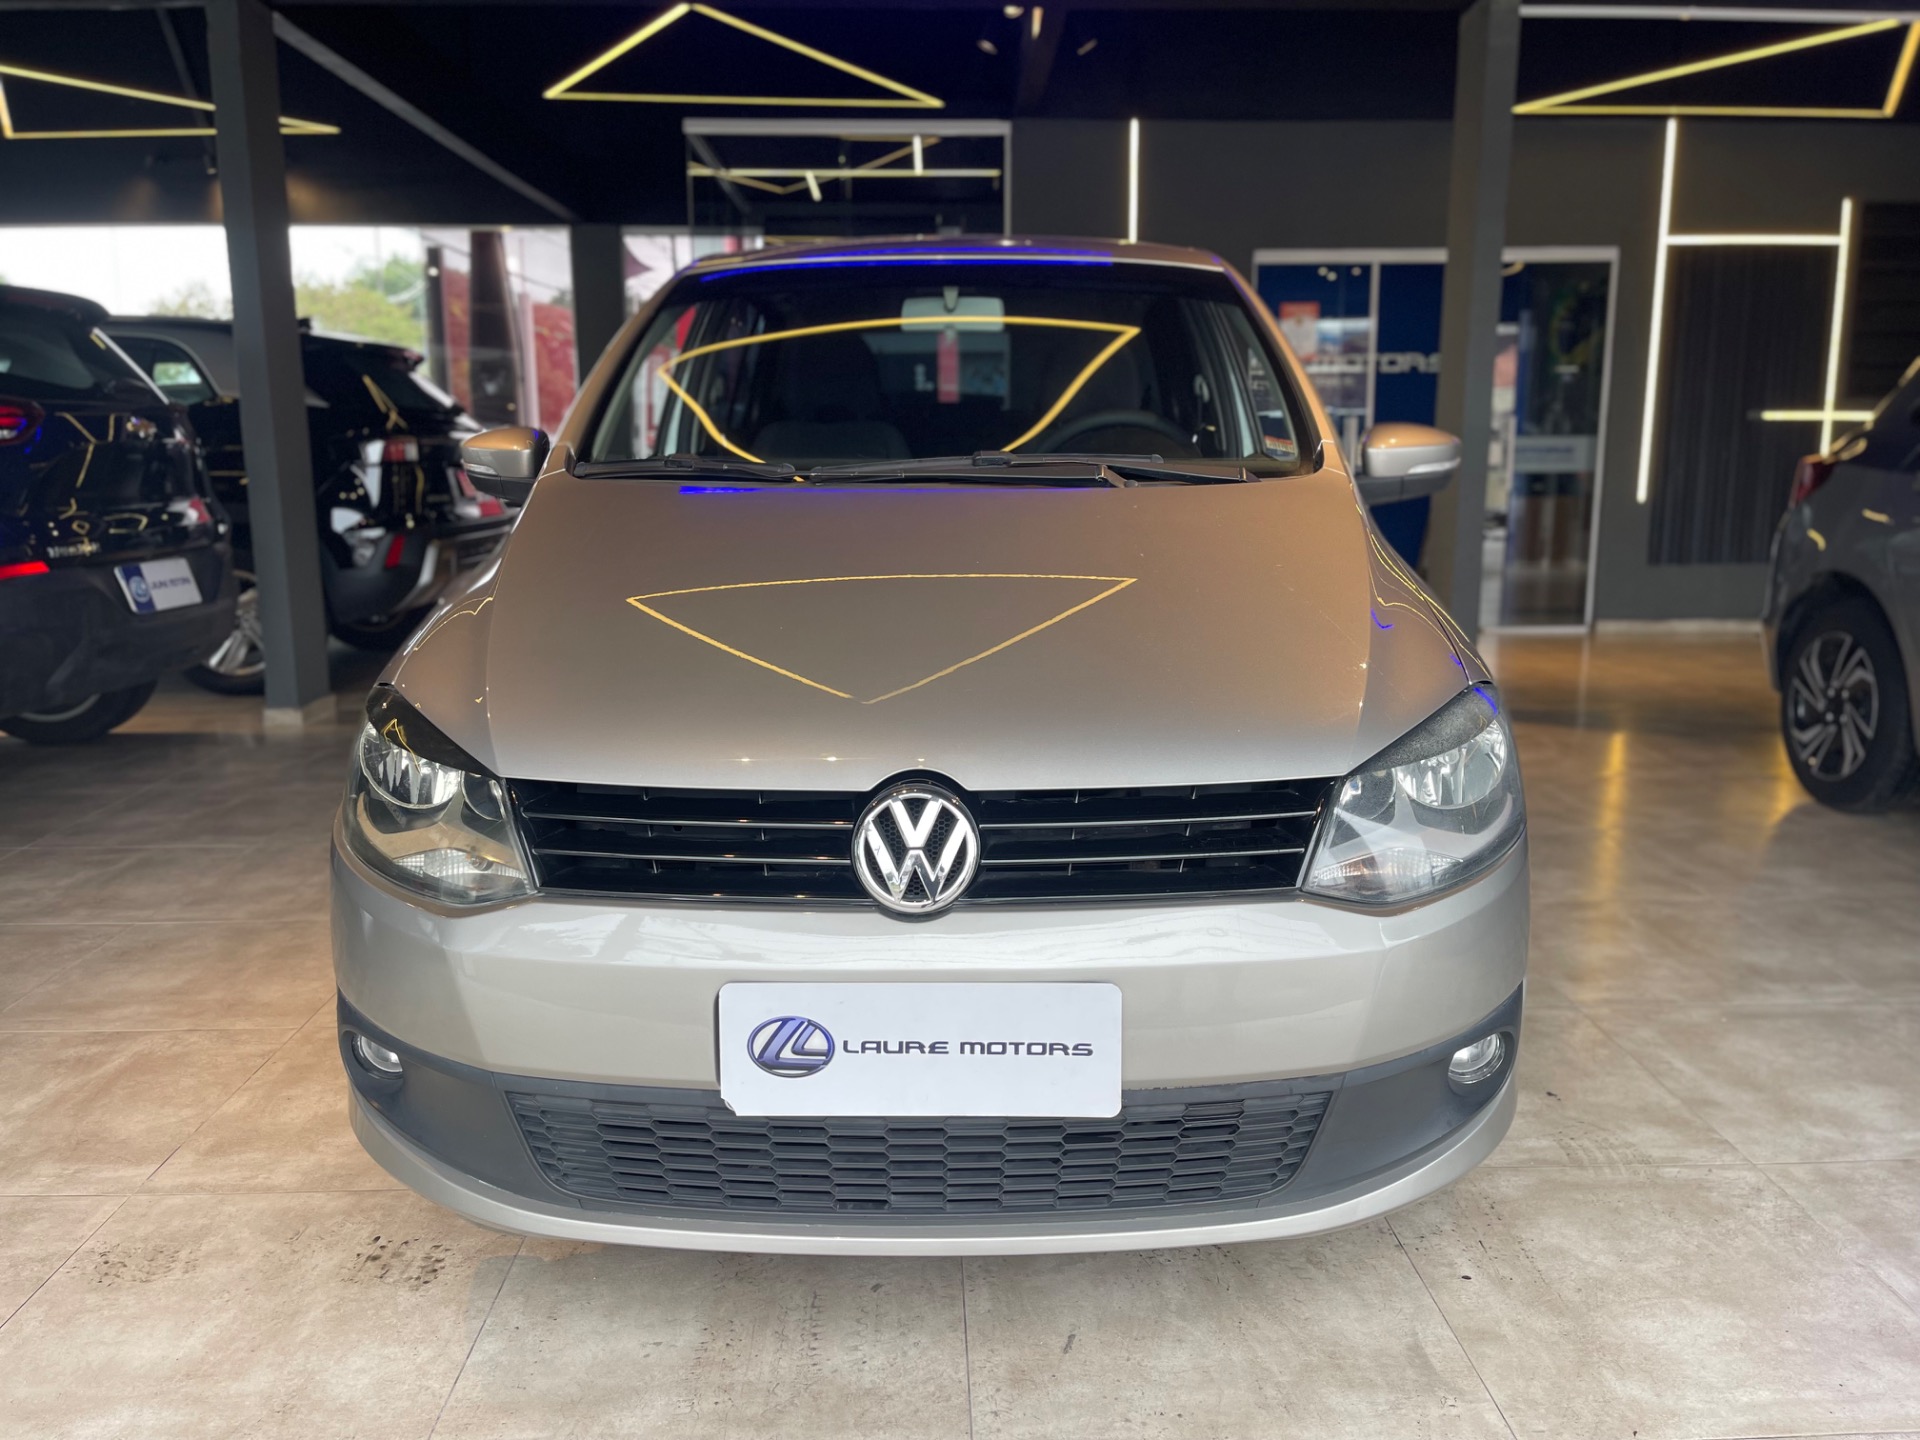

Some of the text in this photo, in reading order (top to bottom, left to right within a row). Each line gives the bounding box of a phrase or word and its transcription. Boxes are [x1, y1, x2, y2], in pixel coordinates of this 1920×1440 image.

[859, 795, 971, 904] VW
[843, 1039, 1094, 1057] LAURE MOTORS
